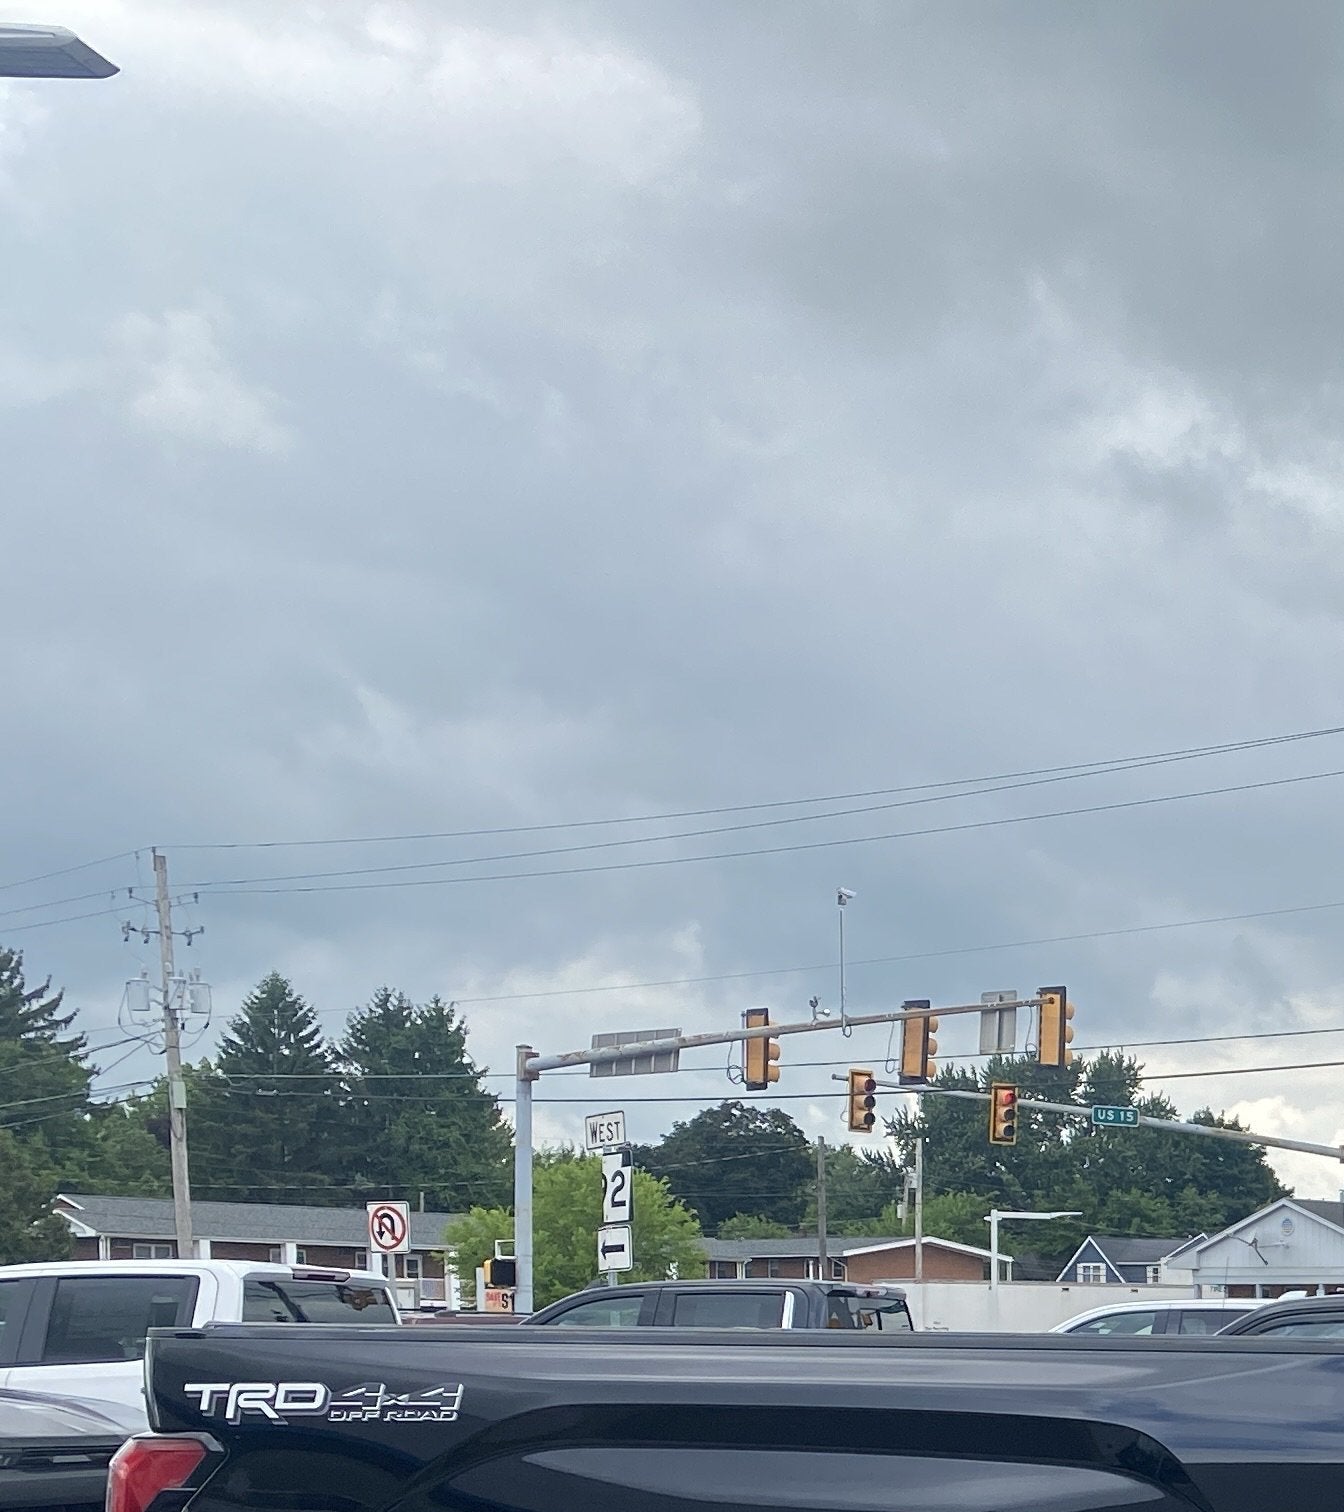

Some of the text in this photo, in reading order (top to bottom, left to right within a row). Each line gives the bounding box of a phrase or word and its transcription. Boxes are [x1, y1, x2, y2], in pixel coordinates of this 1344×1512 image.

[1097, 1109, 1134, 1122] US 15
[589, 1121, 620, 1145] WEST
[184, 1382, 332, 1425] TRD
[328, 1410, 459, 1421] OFF ROAD
